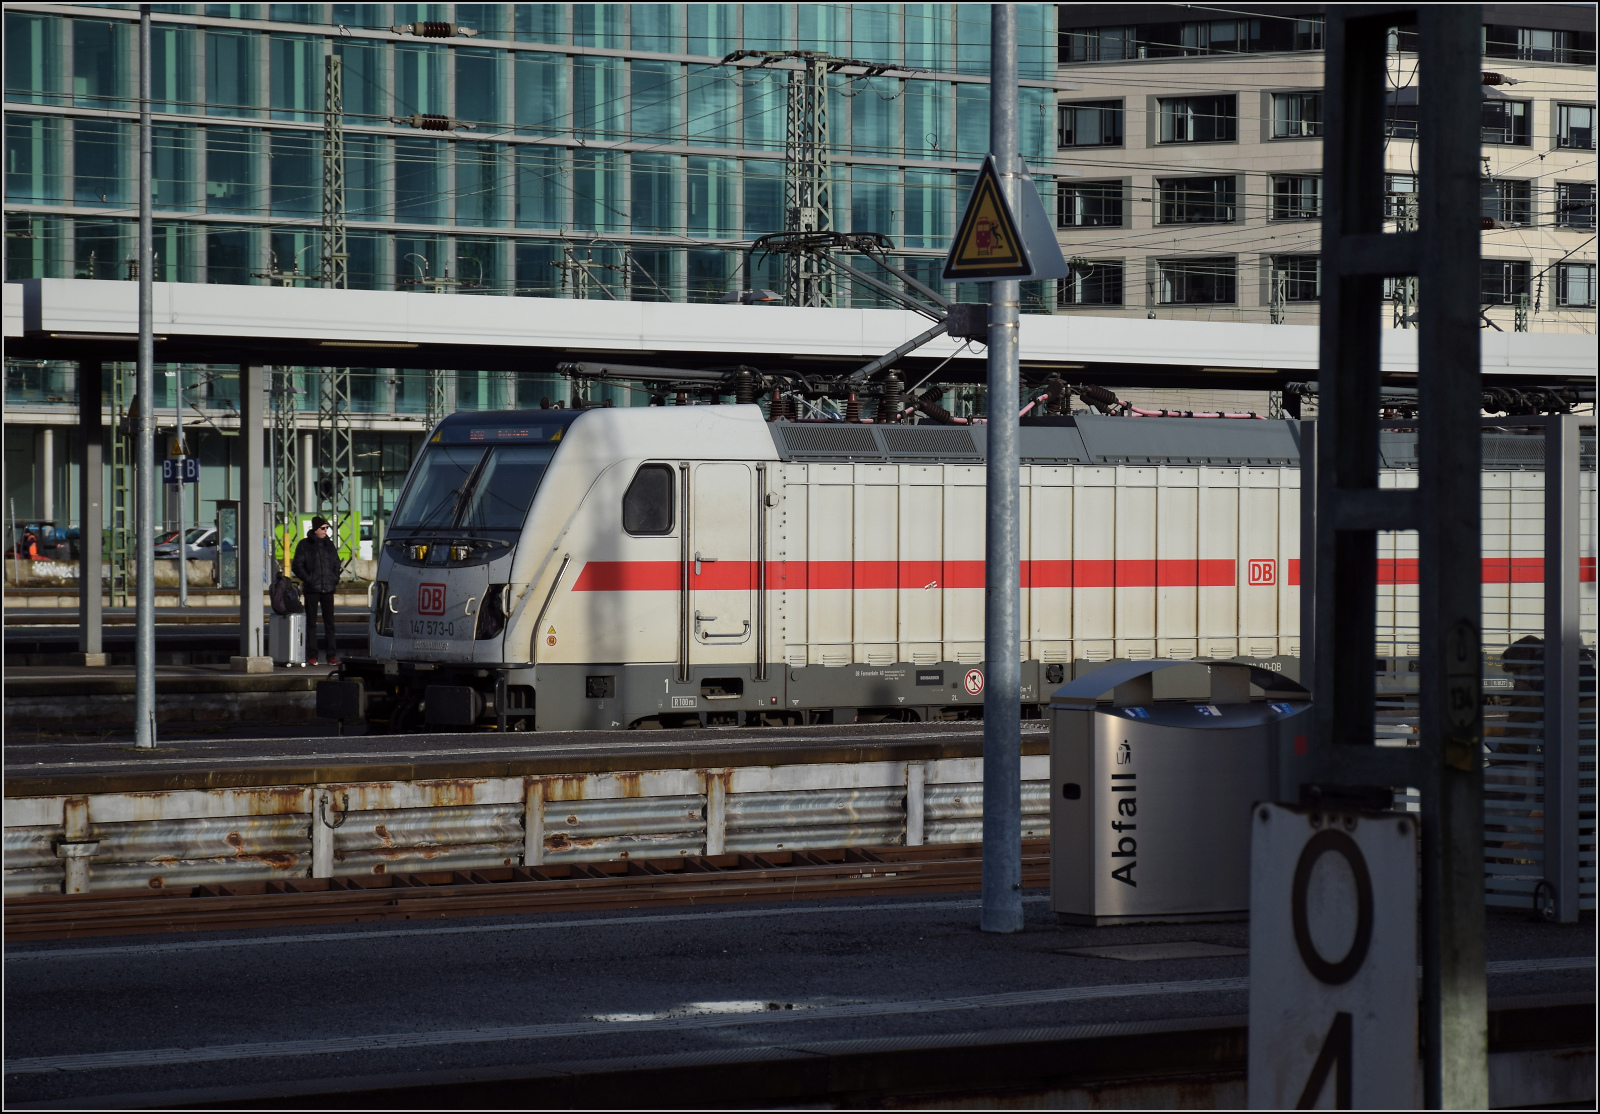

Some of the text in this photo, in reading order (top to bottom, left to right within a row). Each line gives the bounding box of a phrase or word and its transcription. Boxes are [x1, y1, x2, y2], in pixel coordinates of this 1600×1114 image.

[163, 460, 172, 478] B
[187, 459, 195, 477] B
[1252, 563, 1273, 582] DB
[421, 588, 442, 610] DB
[410, 620, 454, 636] 147 573-0
[665, 678, 669, 693] 1
[1111, 773, 1137, 888] Abfall
[1292, 828, 1374, 986] 0
